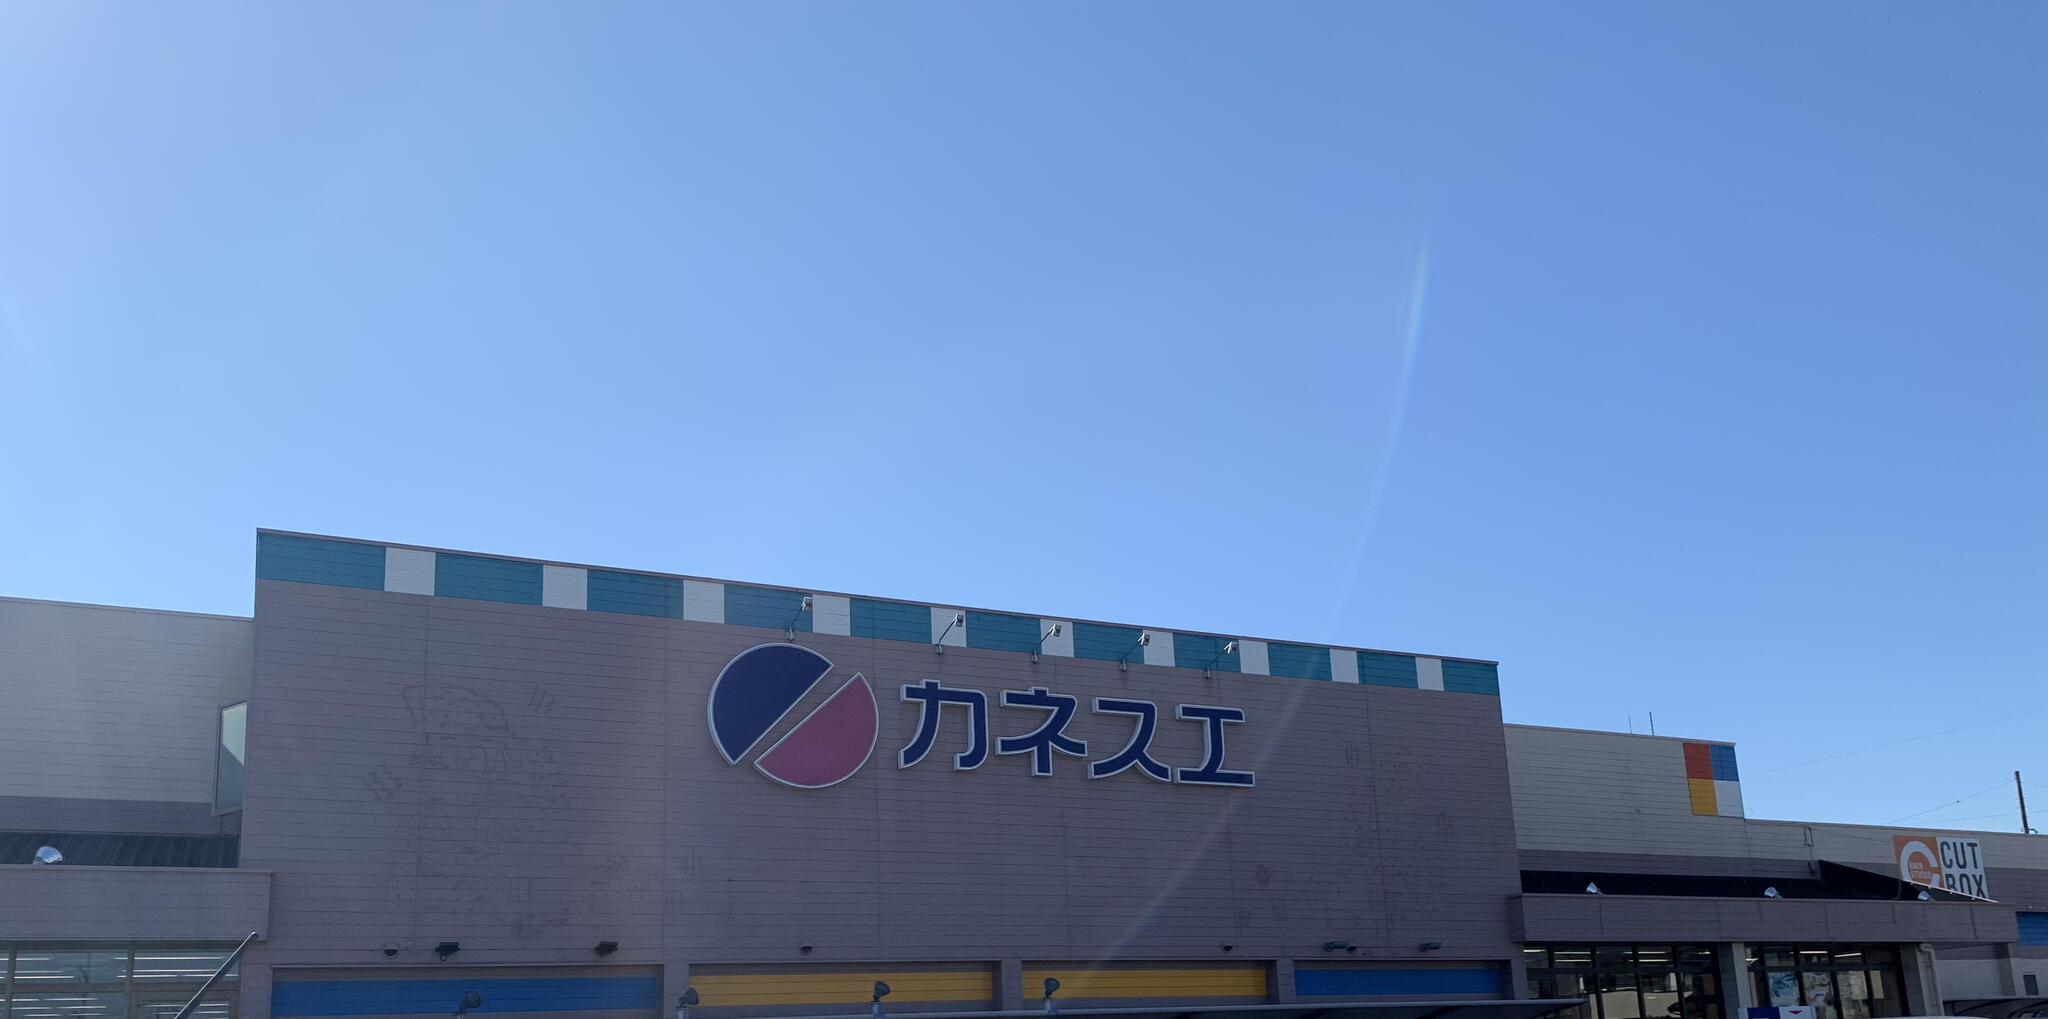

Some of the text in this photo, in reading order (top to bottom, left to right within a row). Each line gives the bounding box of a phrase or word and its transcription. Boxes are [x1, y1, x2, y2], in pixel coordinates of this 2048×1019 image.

[898, 679, 1255, 786] カネスエ
[1940, 841, 1978, 869] CUT
